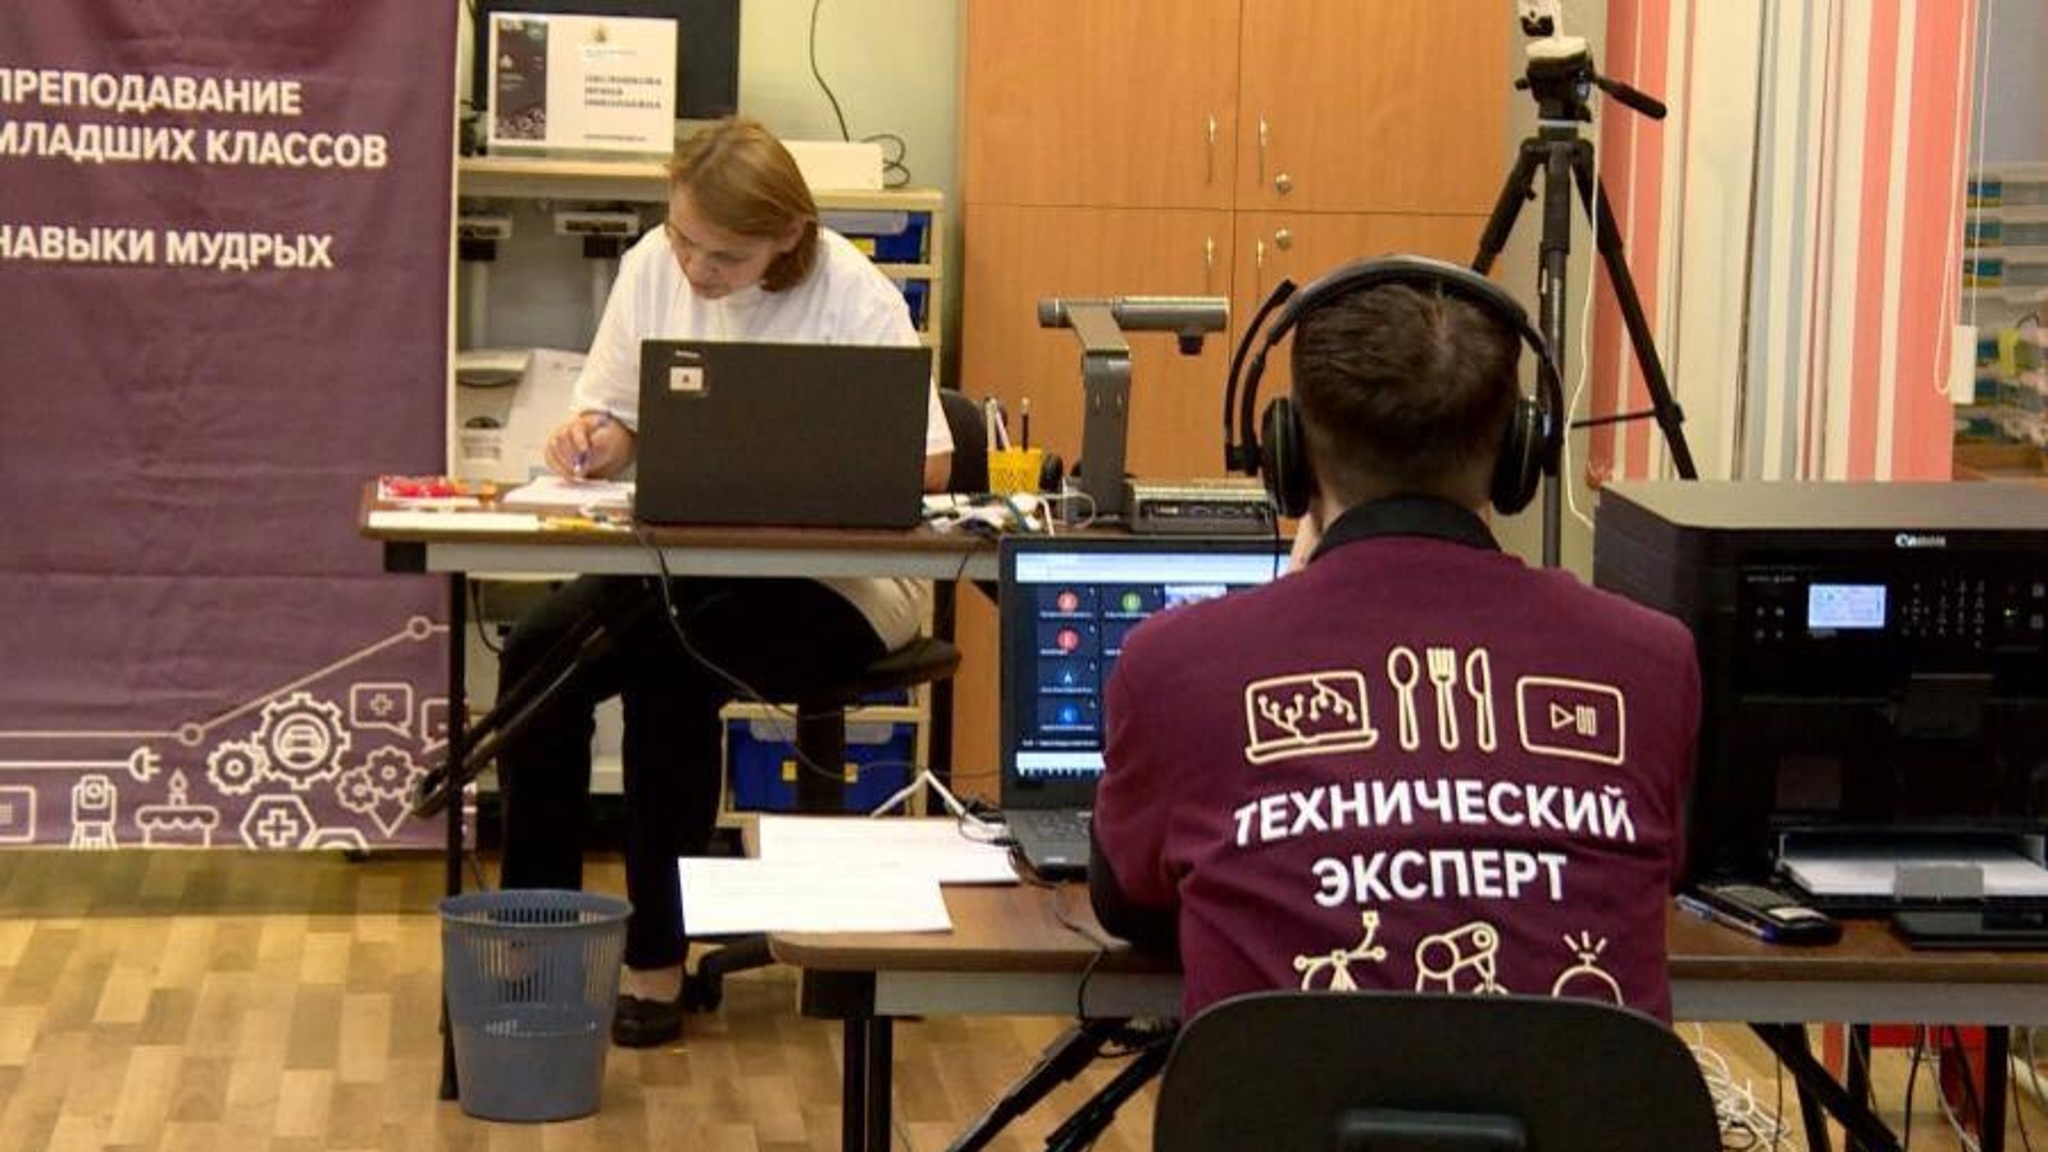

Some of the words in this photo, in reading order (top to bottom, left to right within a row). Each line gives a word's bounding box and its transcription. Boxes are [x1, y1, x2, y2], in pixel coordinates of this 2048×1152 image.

[206, 130, 388, 168] КЛАССОВ
[166, 231, 333, 270] МУДРЫХ
[1234, 780, 1636, 846] ТЕХНИЧЕСКИЙ
[1312, 850, 1567, 907] ЭКСПЕРТ
